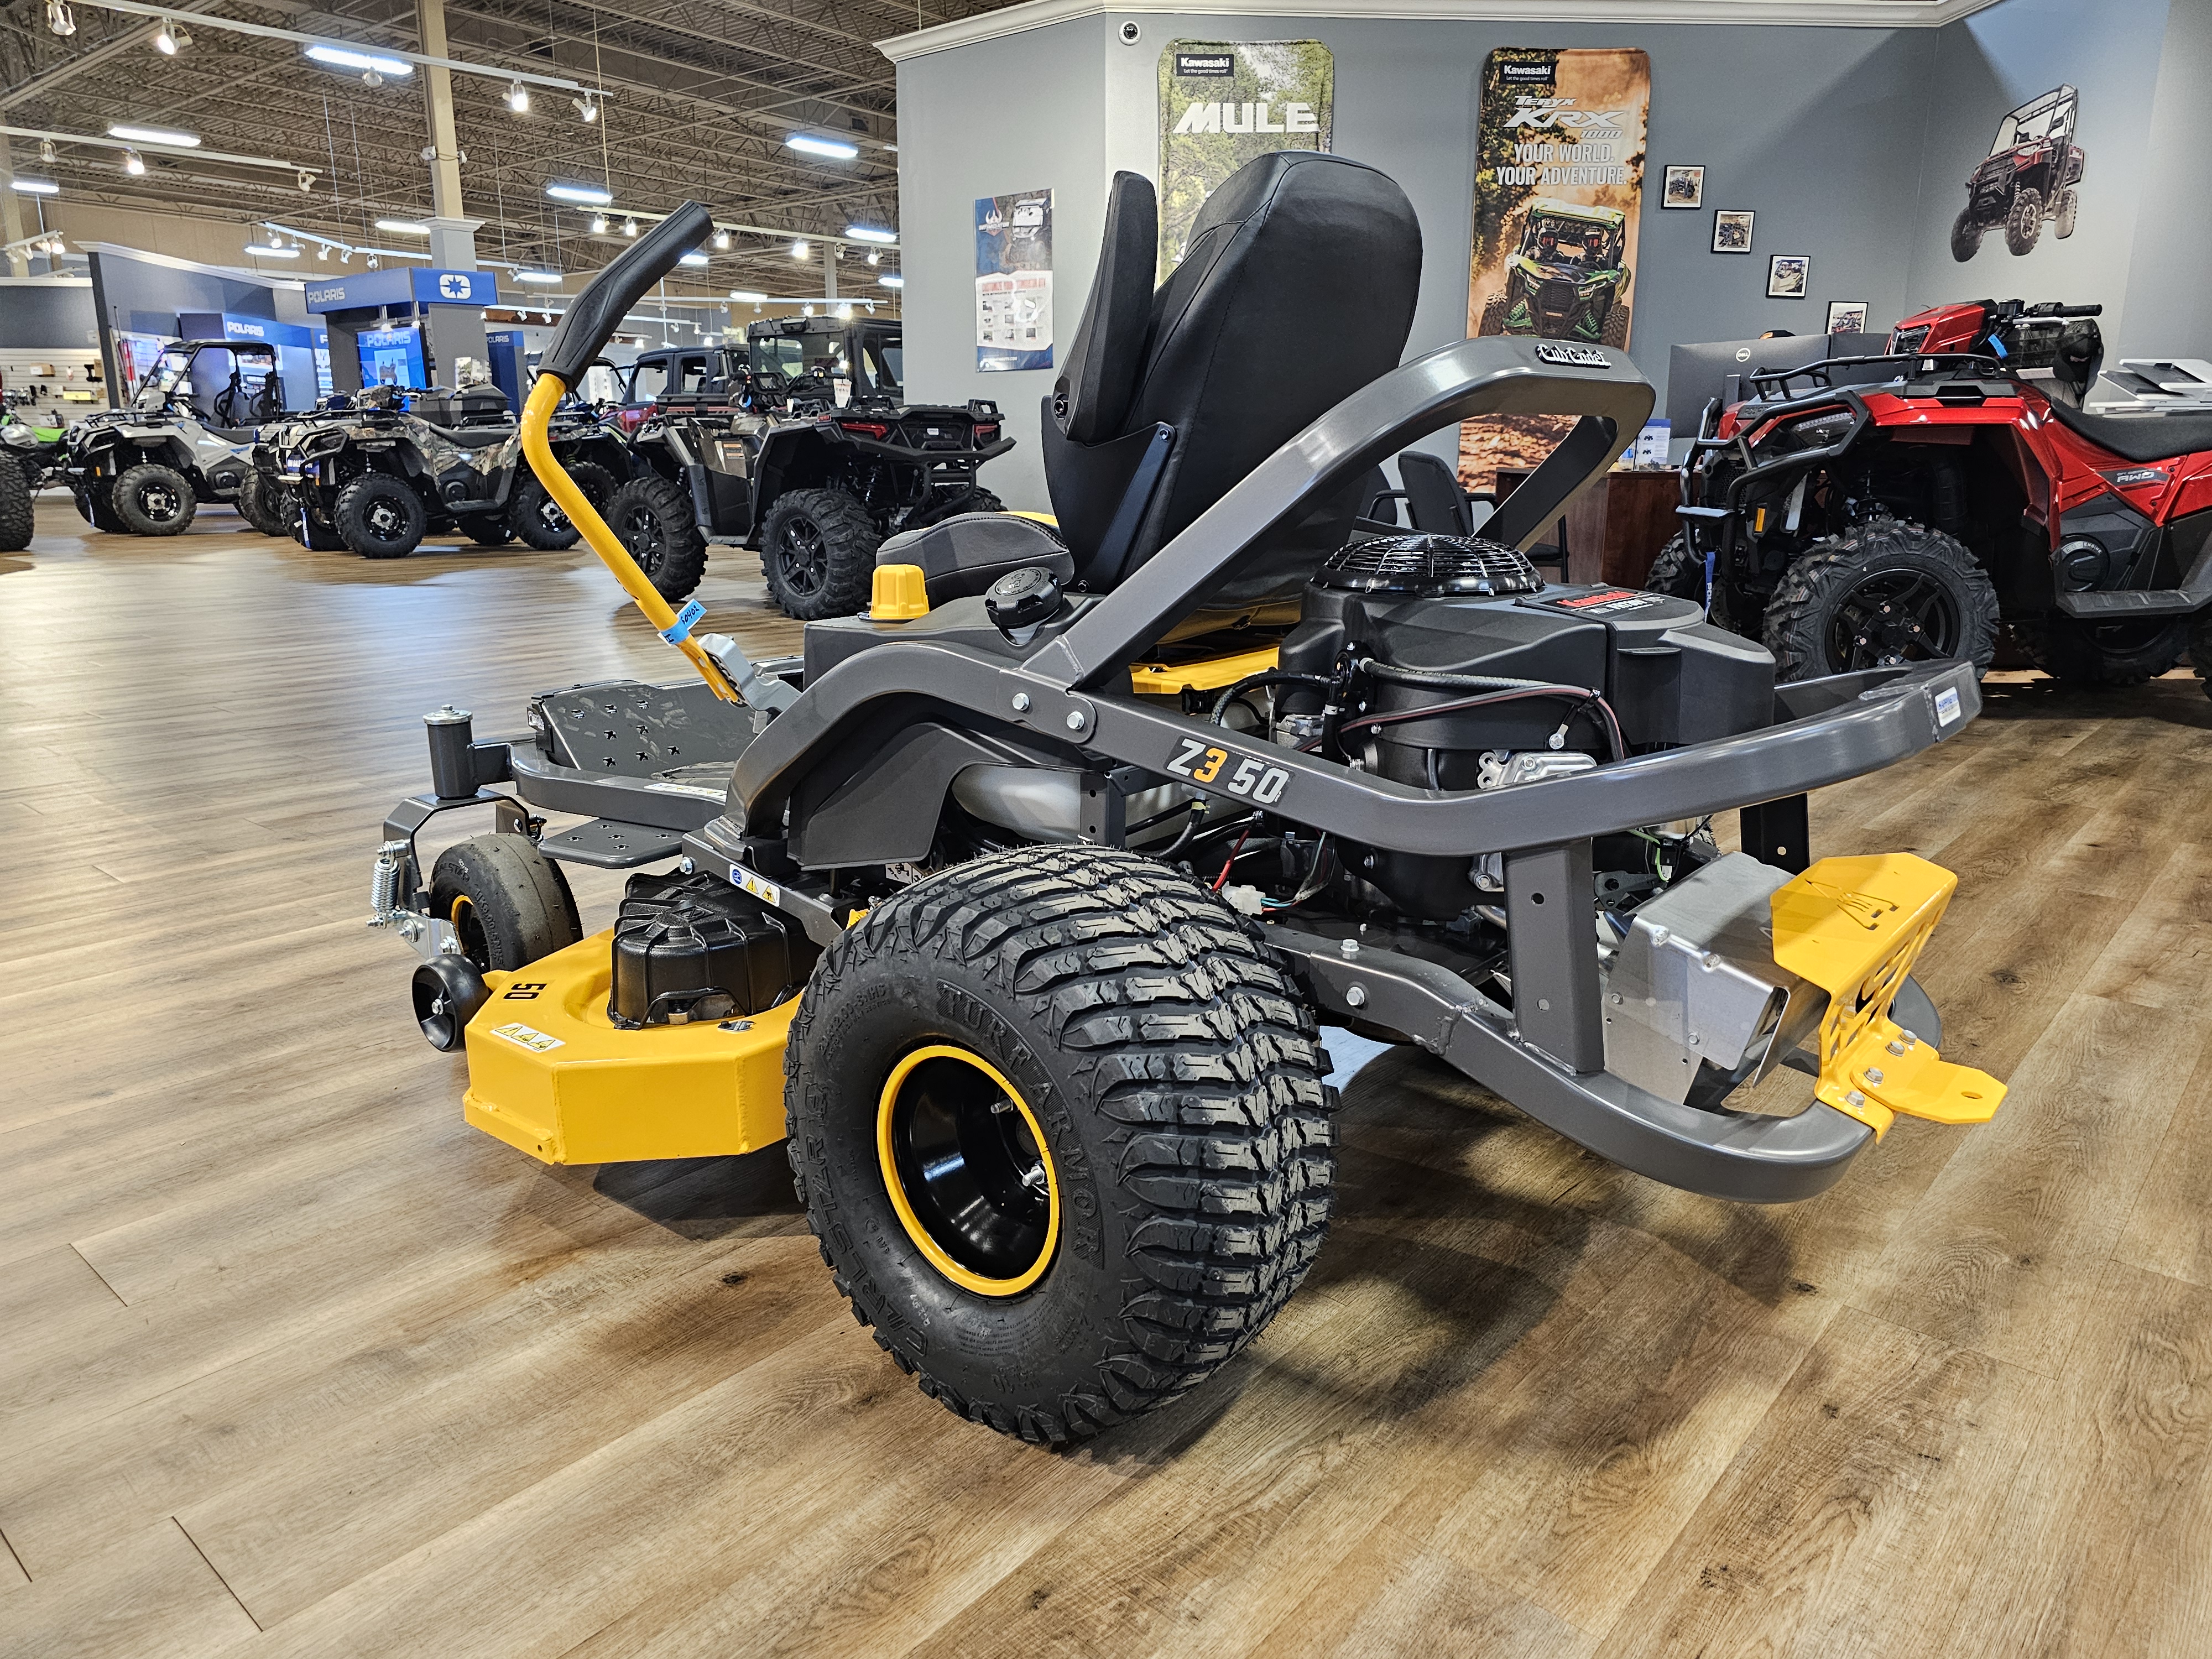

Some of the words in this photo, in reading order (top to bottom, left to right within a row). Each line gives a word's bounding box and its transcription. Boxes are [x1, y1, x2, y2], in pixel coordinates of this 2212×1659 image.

[1181, 58, 1229, 67] Kawasaki
[1504, 65, 1551, 75] Kawasaki
[1173, 102, 1320, 133] MULE
[1503, 107, 1625, 128] KRX
[1580, 129, 1623, 138] 1000
[1514, 144, 1554, 163] YOUR
[1559, 144, 1614, 163] WORLD.
[1496, 166, 1536, 185] YOUR
[1540, 167, 1627, 185] ADVENTURE.
[308, 287, 345, 304] POLARIS
[227, 321, 264, 336] POLARIS
[367, 331, 411, 347] POLARIS
[1537, 343, 1568, 362] Cub
[1566, 347, 1611, 366] Cadet
[2117, 472, 2154, 482] AWD
[1228, 758, 1289, 804] 50
[503, 983, 547, 999] 50
[942, 984, 1033, 1071] TURF
[1027, 1082, 1100, 1254] ARMOR
